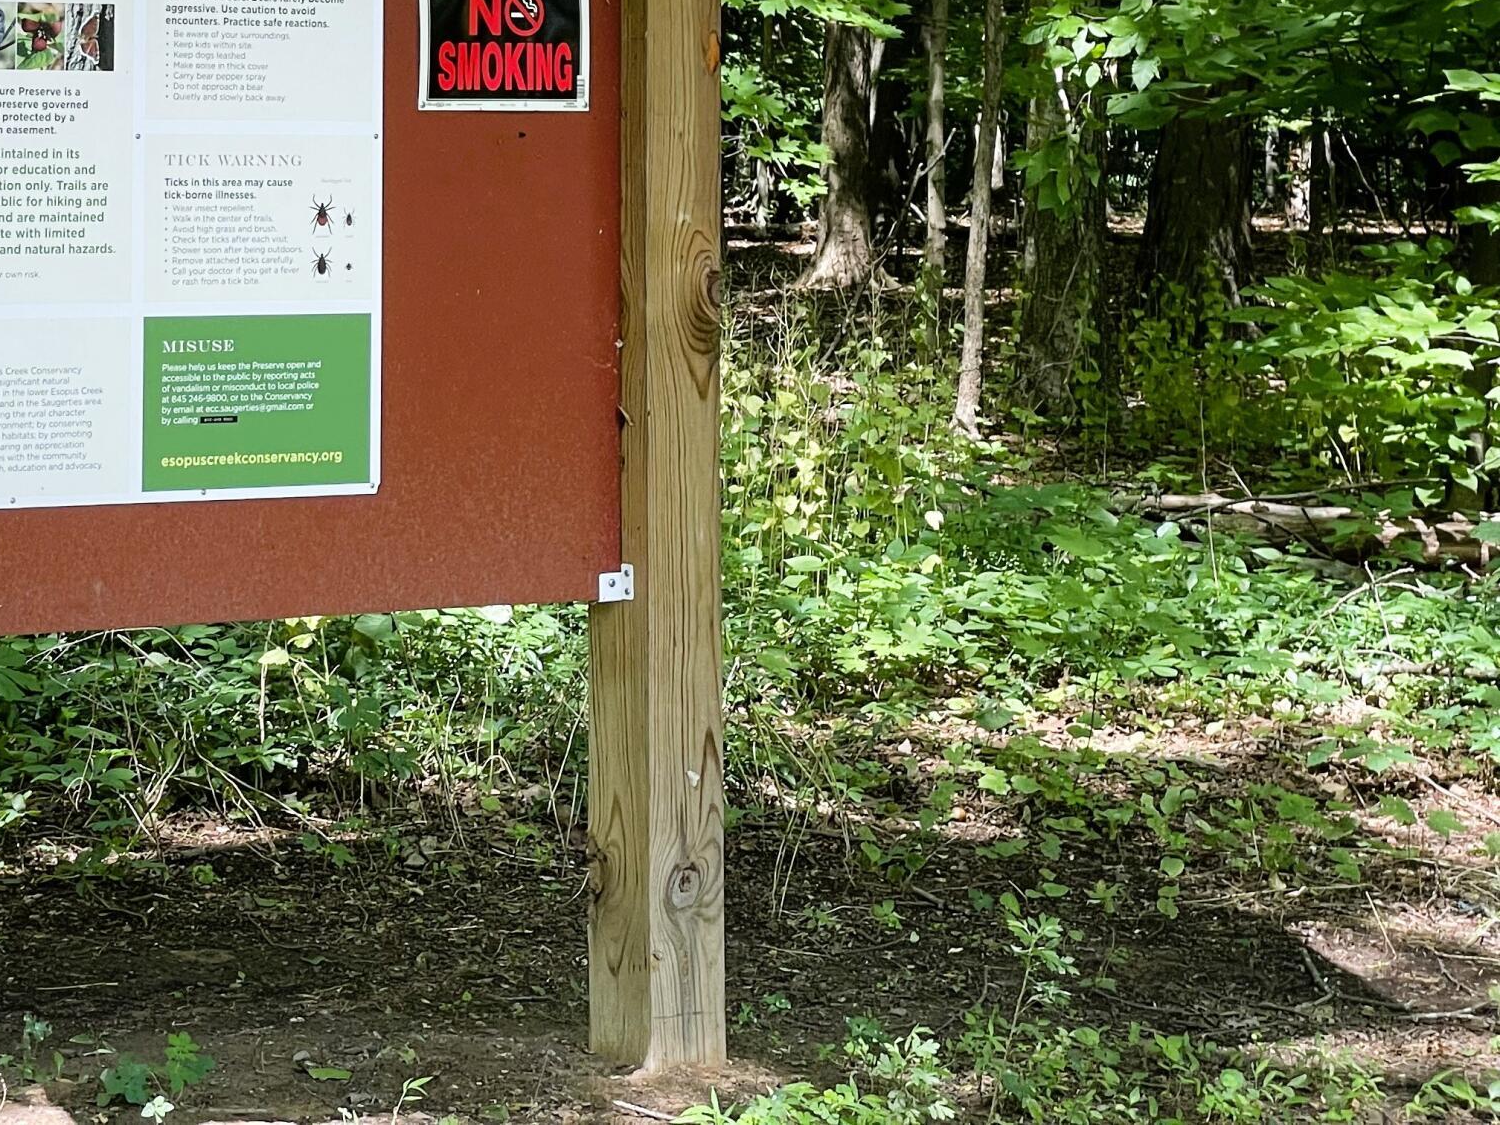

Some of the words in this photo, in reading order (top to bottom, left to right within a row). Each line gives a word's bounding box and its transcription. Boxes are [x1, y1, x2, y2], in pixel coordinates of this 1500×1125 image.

[165, 3, 218, 14] aggressive.
[221, 4, 238, 13] Use
[241, 5, 275, 14] caution
[278, 6, 288, 14] to
[290, 6, 315, 15] avoid
[165, 17, 220, 25] encounters.
[223, 17, 260, 26] Practice
[263, 17, 282, 27] safe
[284, 20, 329, 28] reactions.
[438, 41, 572, 91] SMOKING
[18, 86, 61, 96] Preserve
[64, 86, 72, 96] is
[41, 100, 88, 110] governed
[2, 112, 51, 122] protected
[54, 112, 66, 123] by
[69, 114, 75, 122] a
[6, 126, 56, 134] easement.
[164, 154, 209, 166] TICK
[218, 154, 301, 166] WARNING
[25, 180, 52, 192] only.
[56, 179, 87, 190] Trails
[90, 182, 108, 190] are
[164, 177, 188, 186] Ticks
[191, 178, 199, 186] in
[202, 177, 219, 186] this
[244, 179, 264, 188] may
[164, 190, 212, 199] tick-borne
[215, 190, 256, 199] illnesses.
[16, 214, 35, 222] are
[39, 211, 104, 222] maintained
[0, 243, 21, 254] and
[25, 243, 64, 254] natural
[68, 243, 115, 254] hazards.
[162, 339, 234, 353] MISUSE
[161, 373, 201, 382] accessible
[202, 373, 211, 381] to
[212, 373, 226, 381] the
[226, 372, 250, 381] public
[252, 372, 262, 381] by
[263, 372, 298, 380] reporting
[299, 371, 315, 379] acts
[161, 451, 342, 468] esopuscreekconservancy.org
